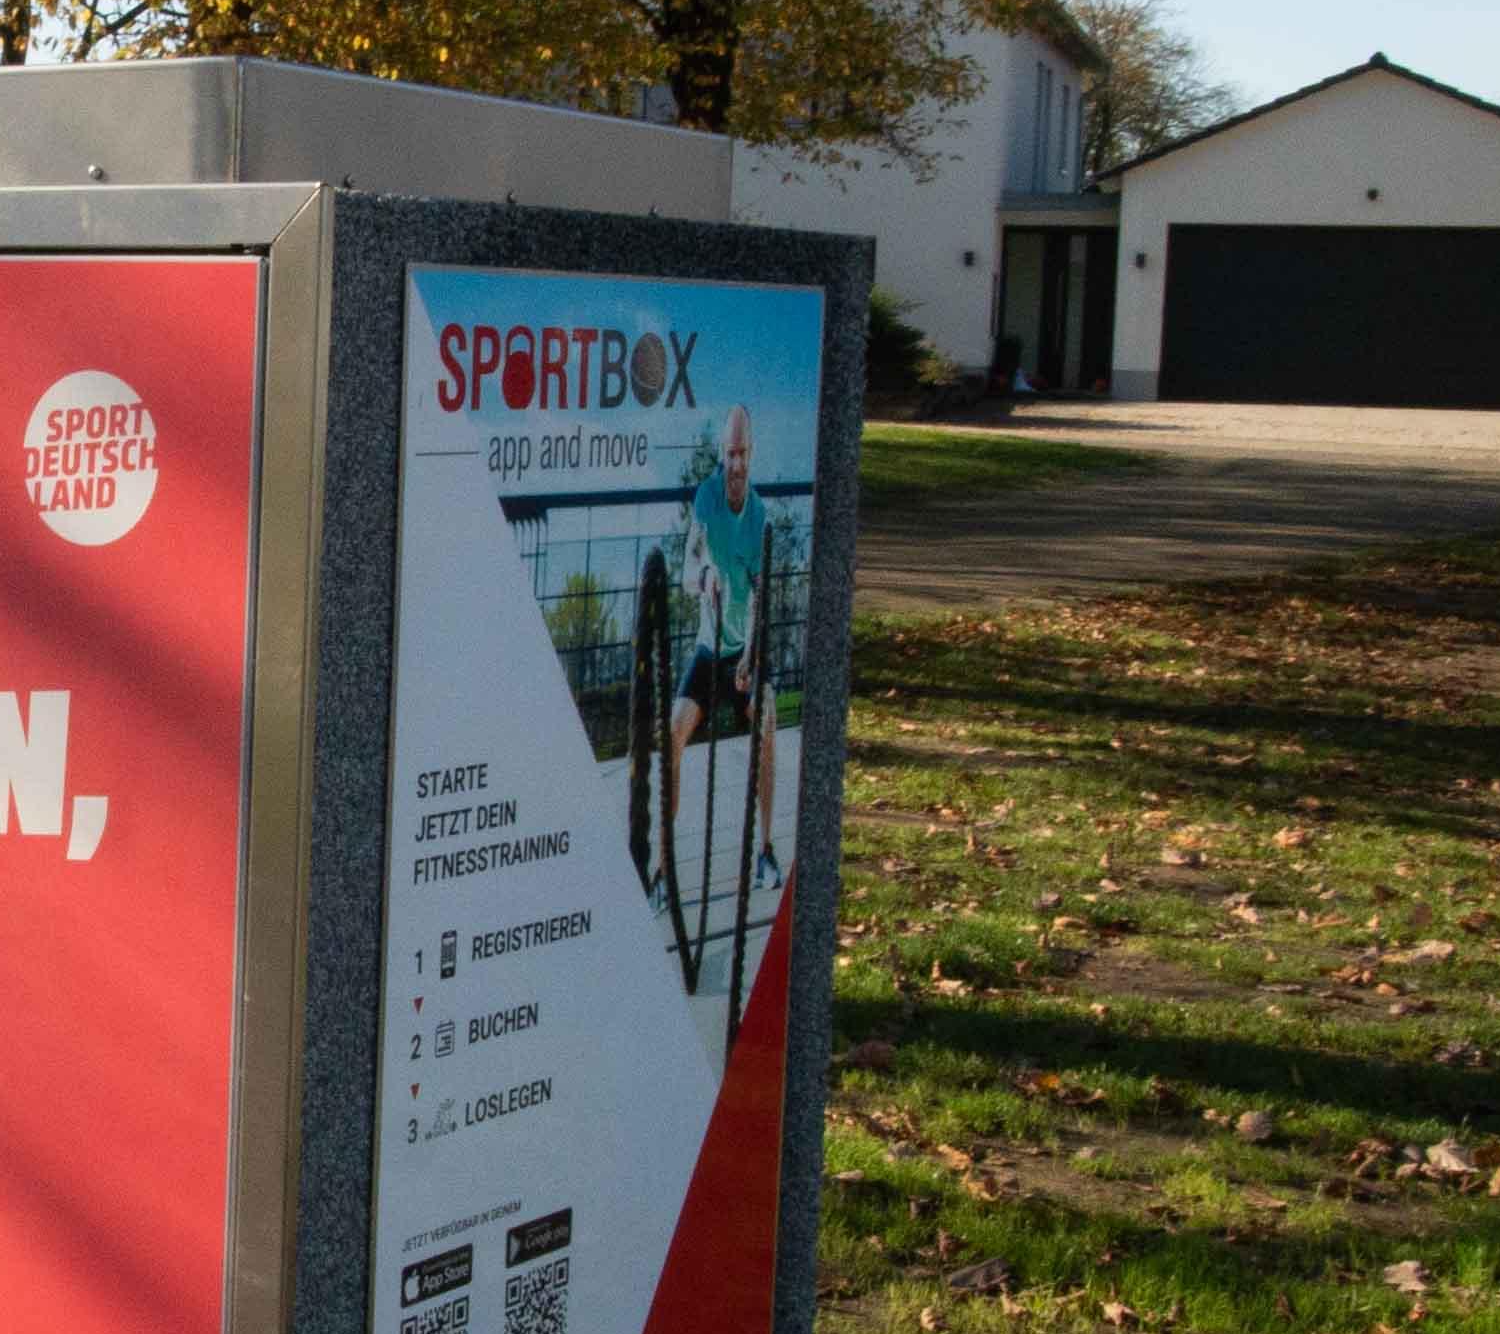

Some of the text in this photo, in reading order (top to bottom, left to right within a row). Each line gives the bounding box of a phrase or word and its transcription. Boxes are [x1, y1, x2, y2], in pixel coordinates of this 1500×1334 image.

[437, 323, 699, 413] SPORTBOX
[46, 402, 151, 443] SPORT
[23, 437, 158, 479] DEUTSCH
[488, 424, 649, 484] app and move
[30, 475, 118, 512] LAND
[416, 762, 489, 799] STARTE
[414, 799, 518, 844] JETZT DEIN
[413, 829, 570, 886] FITNESSTRAINING
[413, 909, 593, 976] 1 REGISTRIEREN
[409, 1002, 540, 1061] 2 BUCHEN
[406, 1077, 553, 1145] 3 LOSLEGEN
[402, 1232, 429, 1253] JETZT
[422, 1264, 470, 1293] App Store
